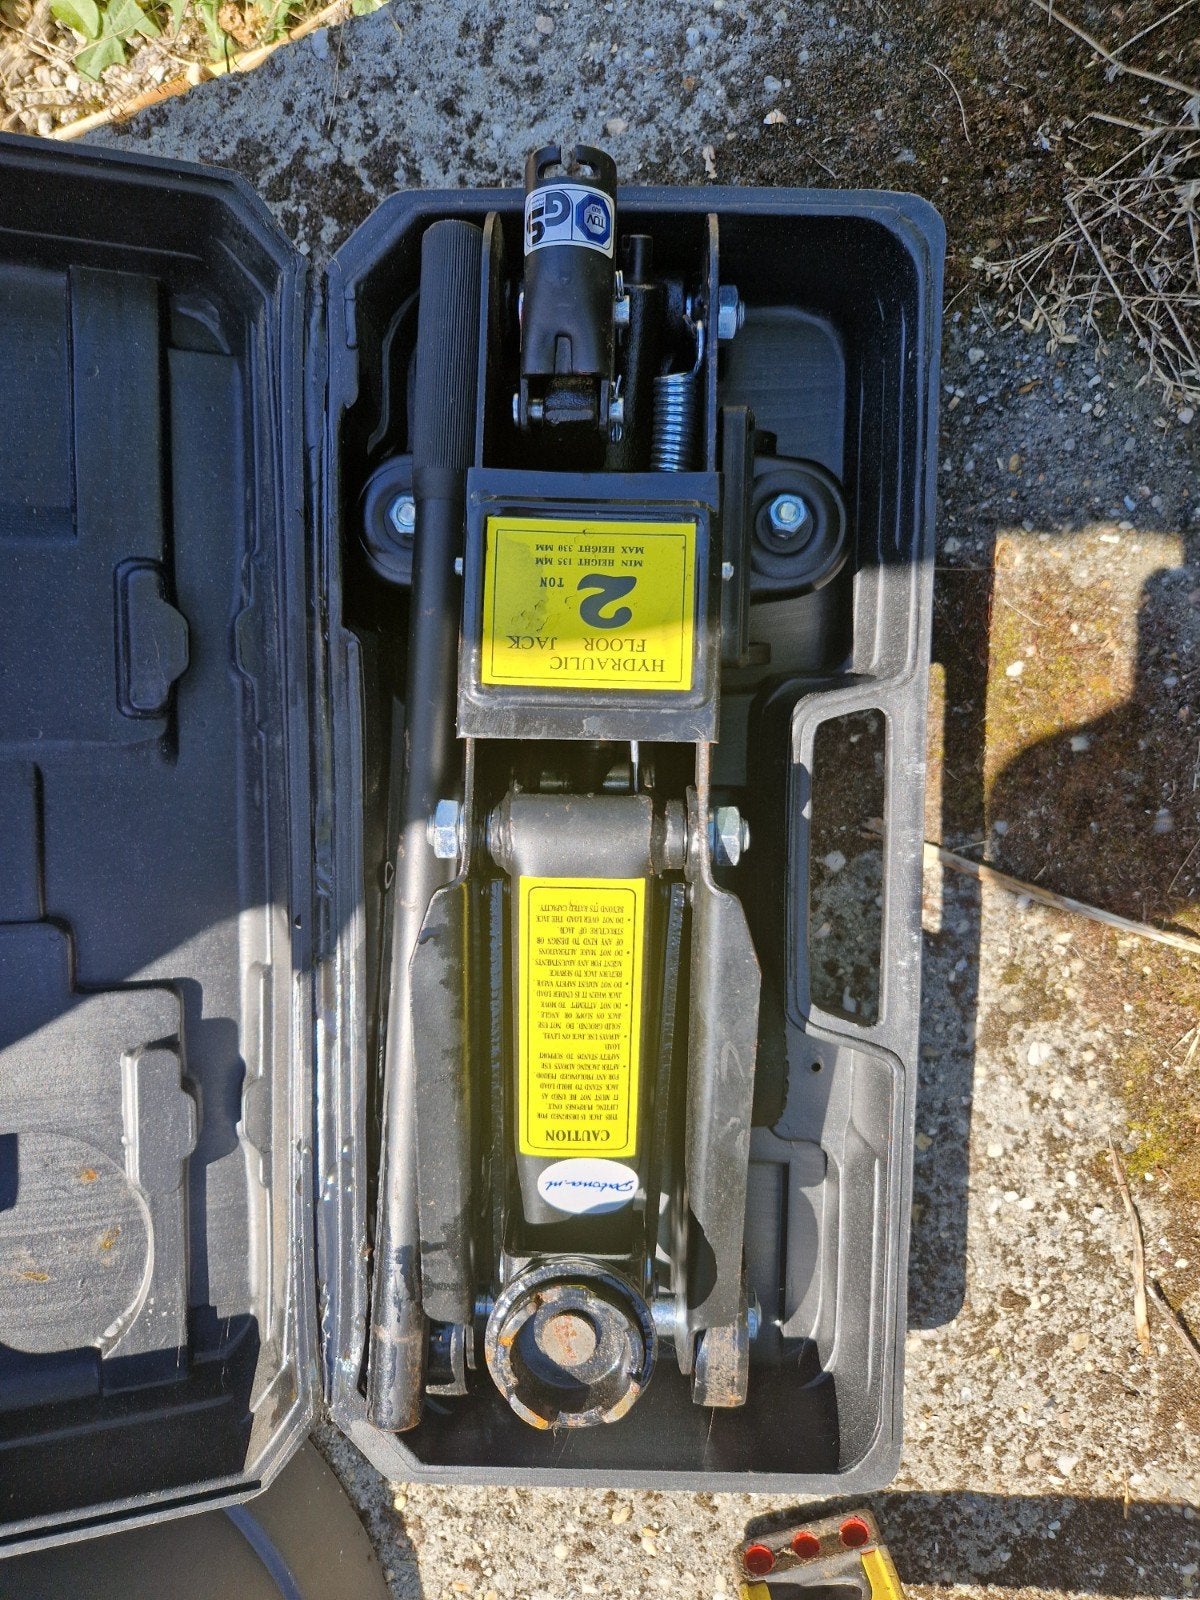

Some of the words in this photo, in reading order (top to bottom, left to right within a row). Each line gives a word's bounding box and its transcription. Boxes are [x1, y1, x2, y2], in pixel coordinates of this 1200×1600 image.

[535, 544, 553, 552] MM
[578, 545, 615, 553] HEIGHT
[621, 546, 644, 554] MAX
[535, 557, 553, 565] MM
[558, 558, 572, 566] 135
[577, 558, 614, 566] HEIGHT
[622, 559, 642, 567] MIN
[540, 577, 564, 588] TON
[576, 573, 637, 629] 2
[506, 635, 558, 650] JACK
[582, 637, 646, 652] FLOOR
[550, 656, 664, 672] HYDRAULIC
[545, 1130, 610, 1141] CAUTION
